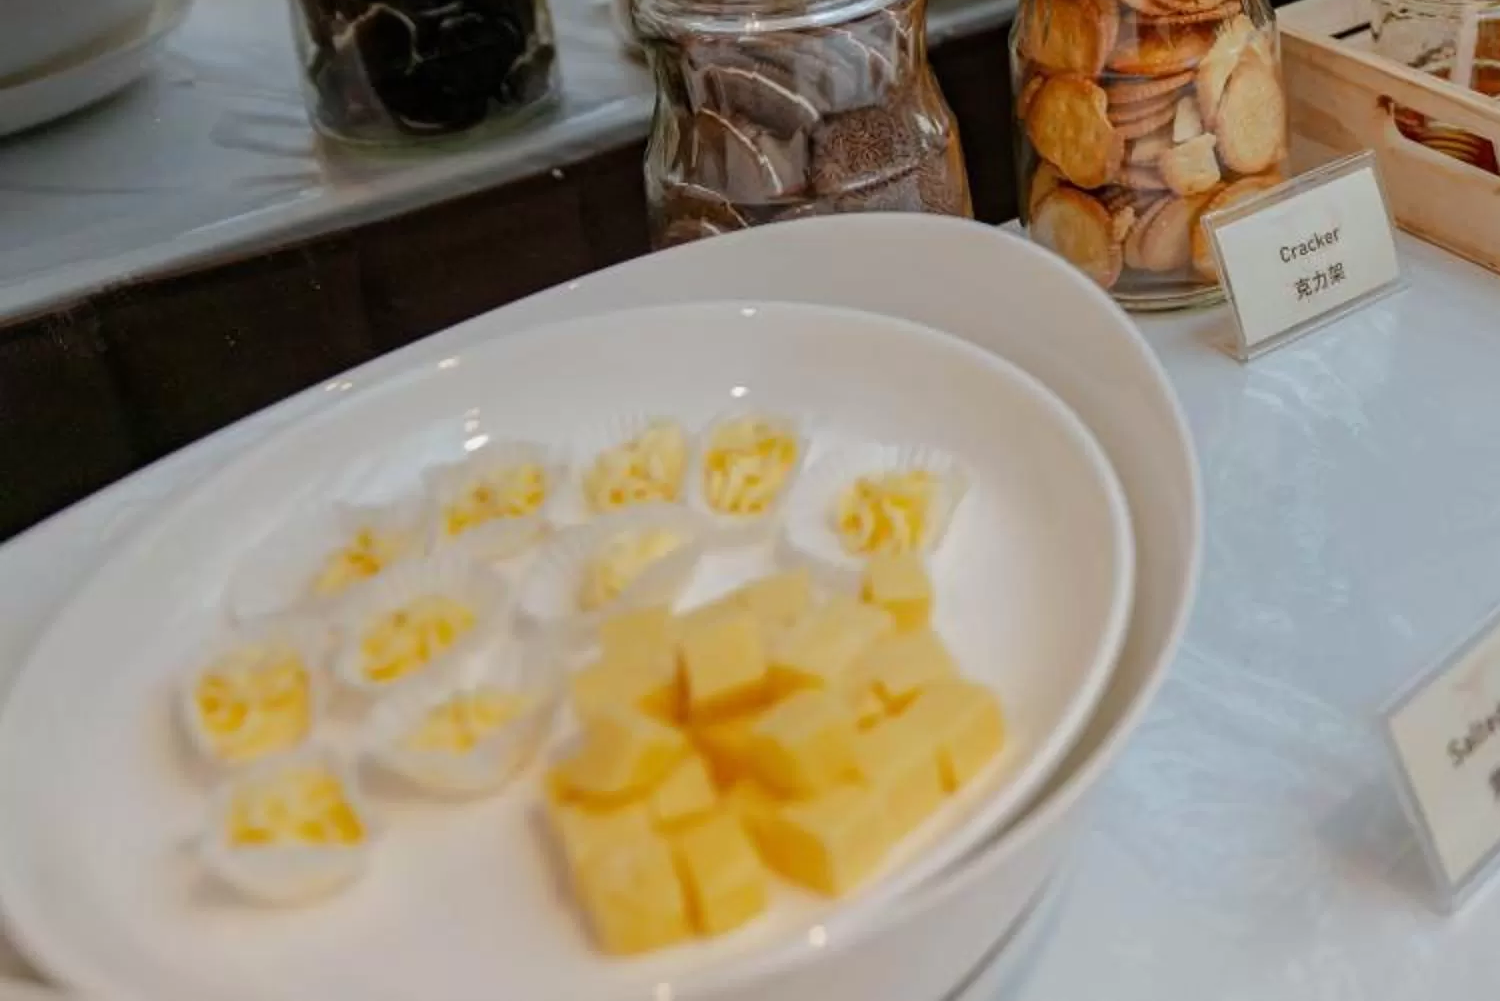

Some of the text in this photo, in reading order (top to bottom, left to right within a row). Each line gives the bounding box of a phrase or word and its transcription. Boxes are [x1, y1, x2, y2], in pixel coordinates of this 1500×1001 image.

[1279, 228, 1340, 264] Cracker
[1295, 262, 1346, 300] 克力架
